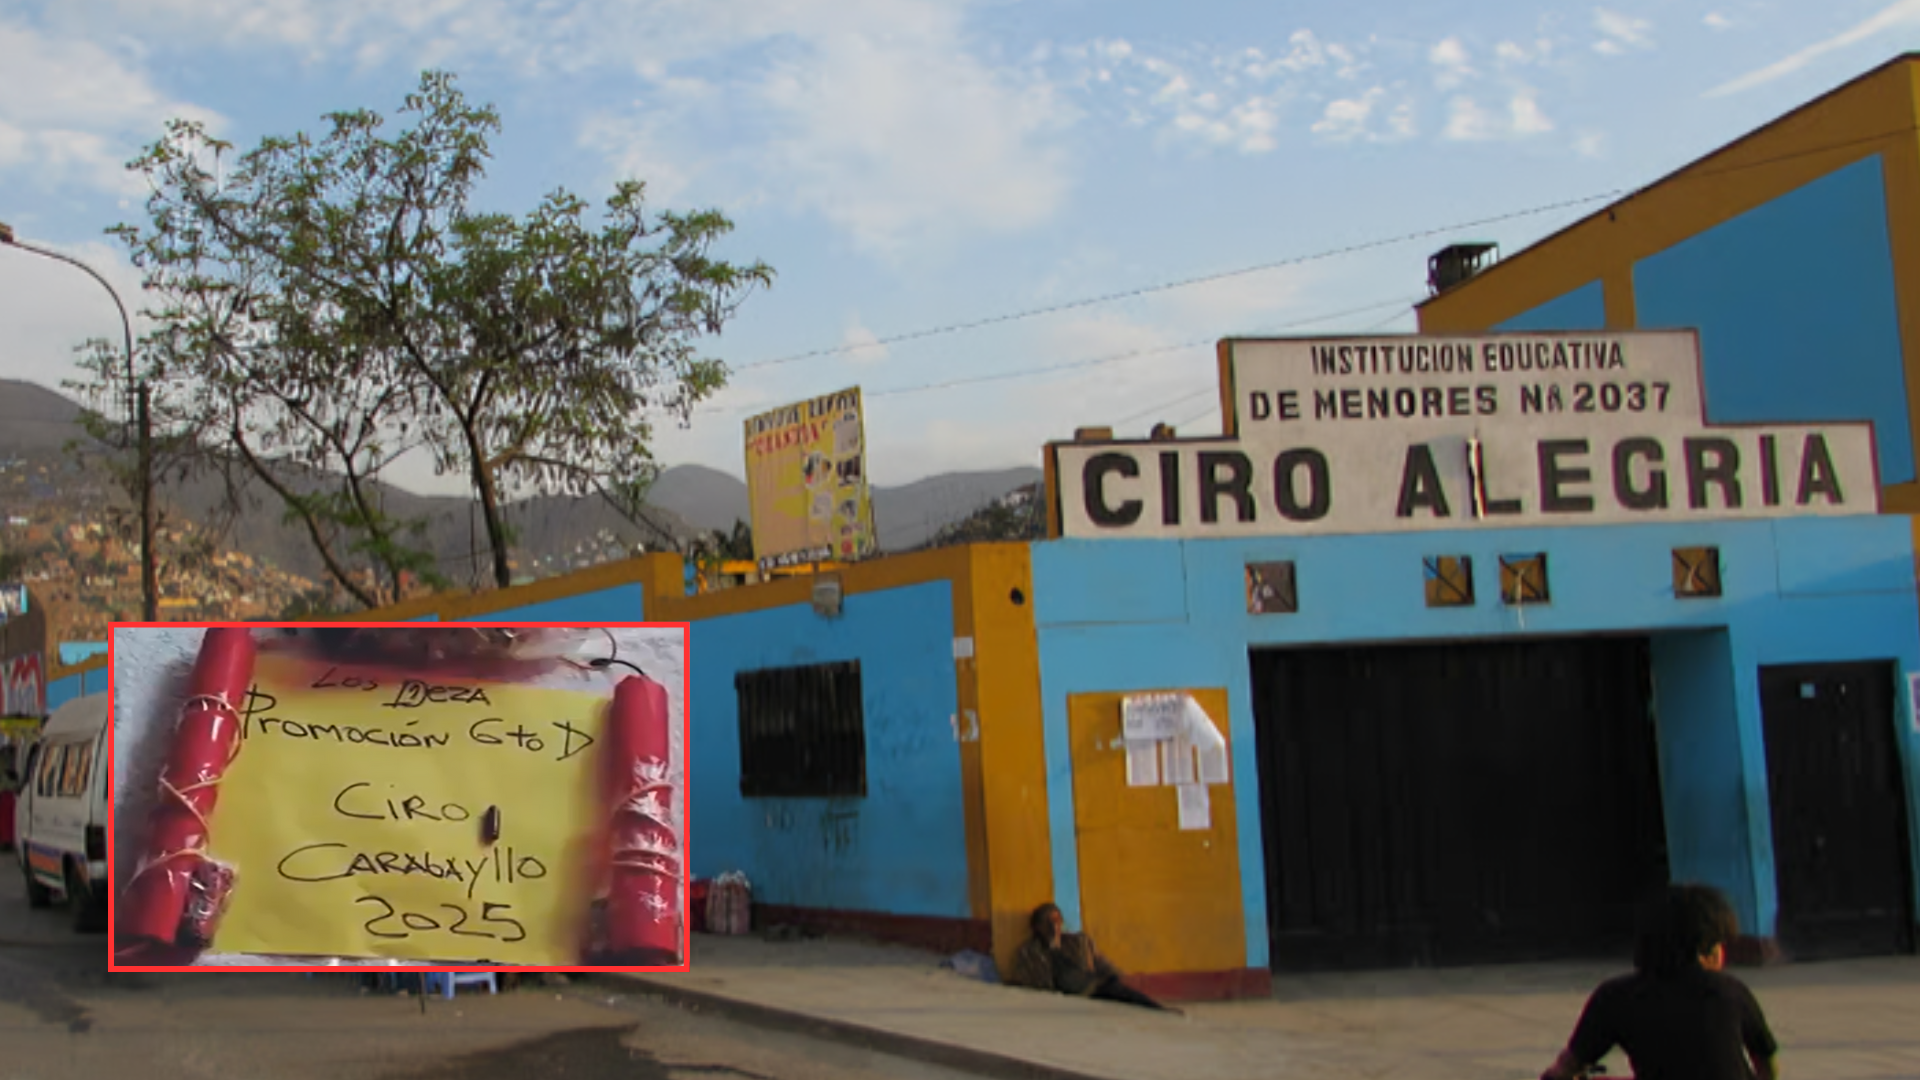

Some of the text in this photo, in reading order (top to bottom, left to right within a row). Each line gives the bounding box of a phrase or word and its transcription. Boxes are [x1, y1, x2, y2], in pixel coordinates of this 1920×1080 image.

[1311, 341, 1625, 375] INSTITUCION EDUCATIVA
[1250, 390, 1299, 421] DE
[1315, 385, 1497, 420] MENORES
[1573, 381, 1671, 412] 2037
[1082, 432, 1843, 529] CIRO ALEGRIA
[311, 667, 379, 691] Los
[552, 721, 595, 761] D
[354, 896, 526, 942] 2025
